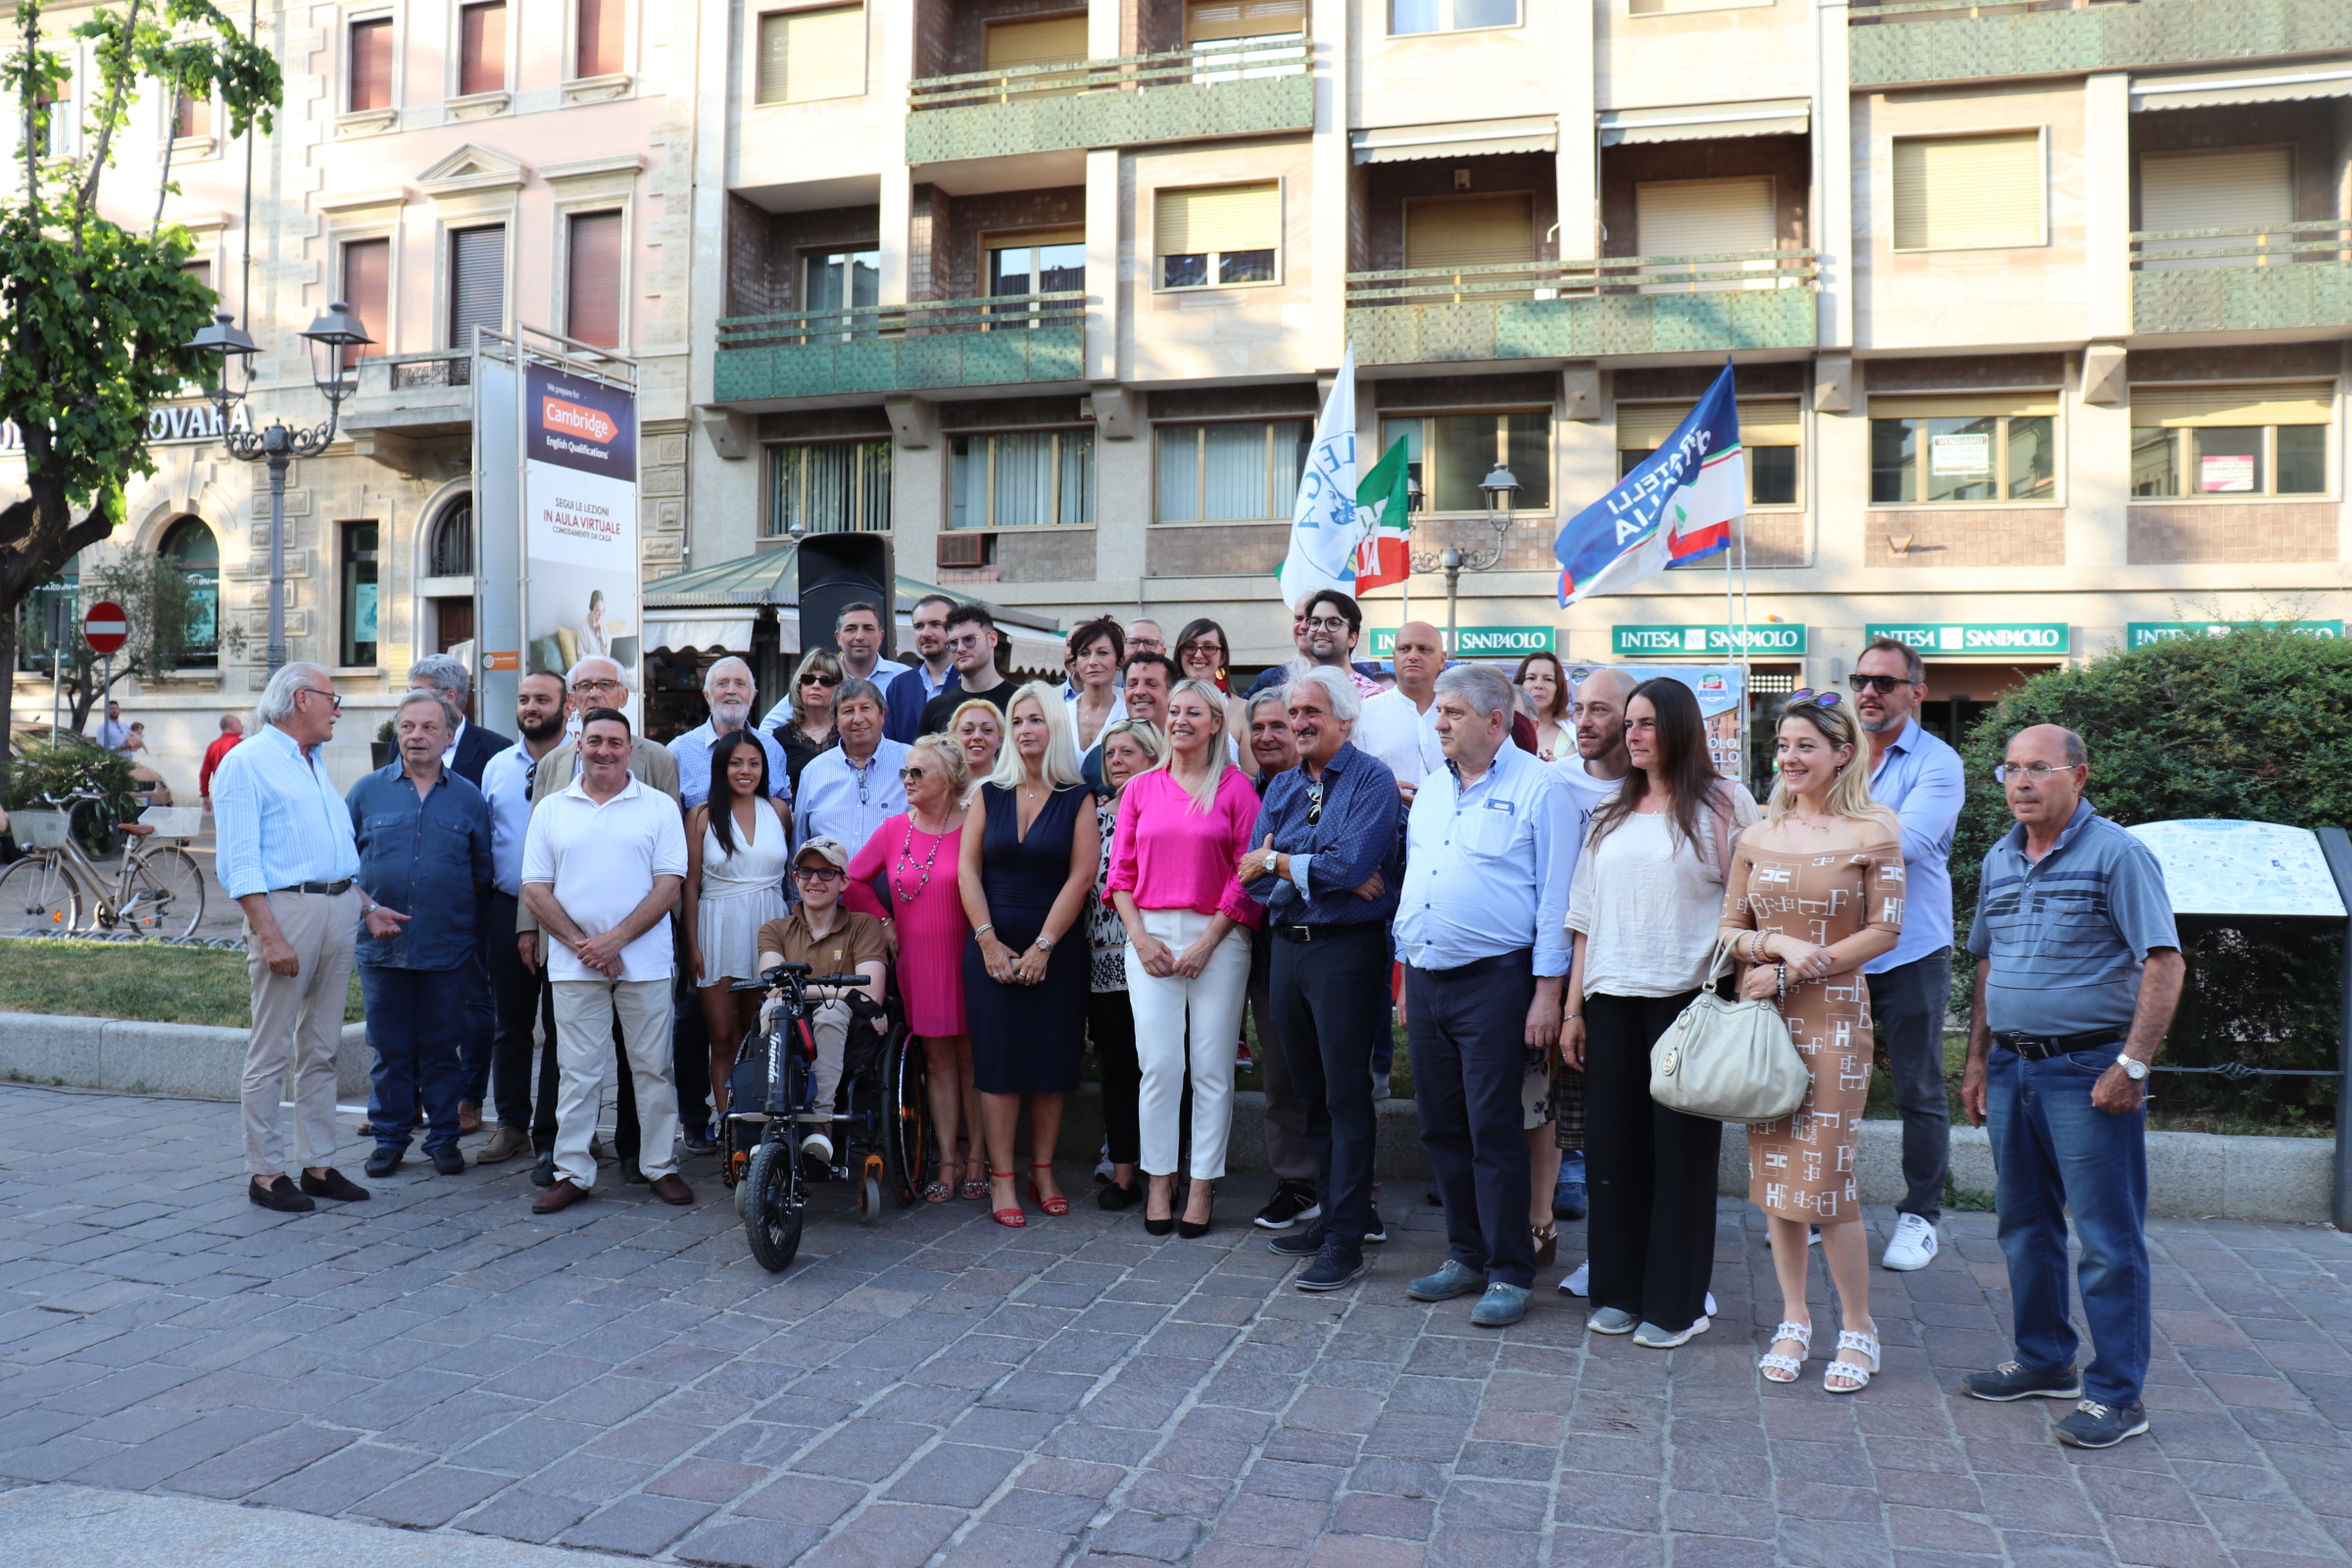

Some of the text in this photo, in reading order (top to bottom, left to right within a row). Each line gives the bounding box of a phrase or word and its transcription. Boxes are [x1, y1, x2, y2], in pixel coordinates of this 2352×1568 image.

[546, 382, 555, 392] We
[555, 386, 573, 398] prepare
[546, 403, 609, 439] Cambridge
[546, 435, 610, 460] English Qualifications
[1938, 436, 1984, 446] VENDIAMO
[555, 497, 610, 516] SEGUI LE LEZIONI
[543, 509, 621, 535] IN AULA VIRTUALE
[552, 525, 590, 539] COMODAMENTE
[598, 533, 612, 543] CASA
[1462, 632, 1546, 650] SANPAOLO
[1621, 630, 1798, 648] INTESA SANPAOLO
[1965, 629, 2060, 648] SANPAOLO
